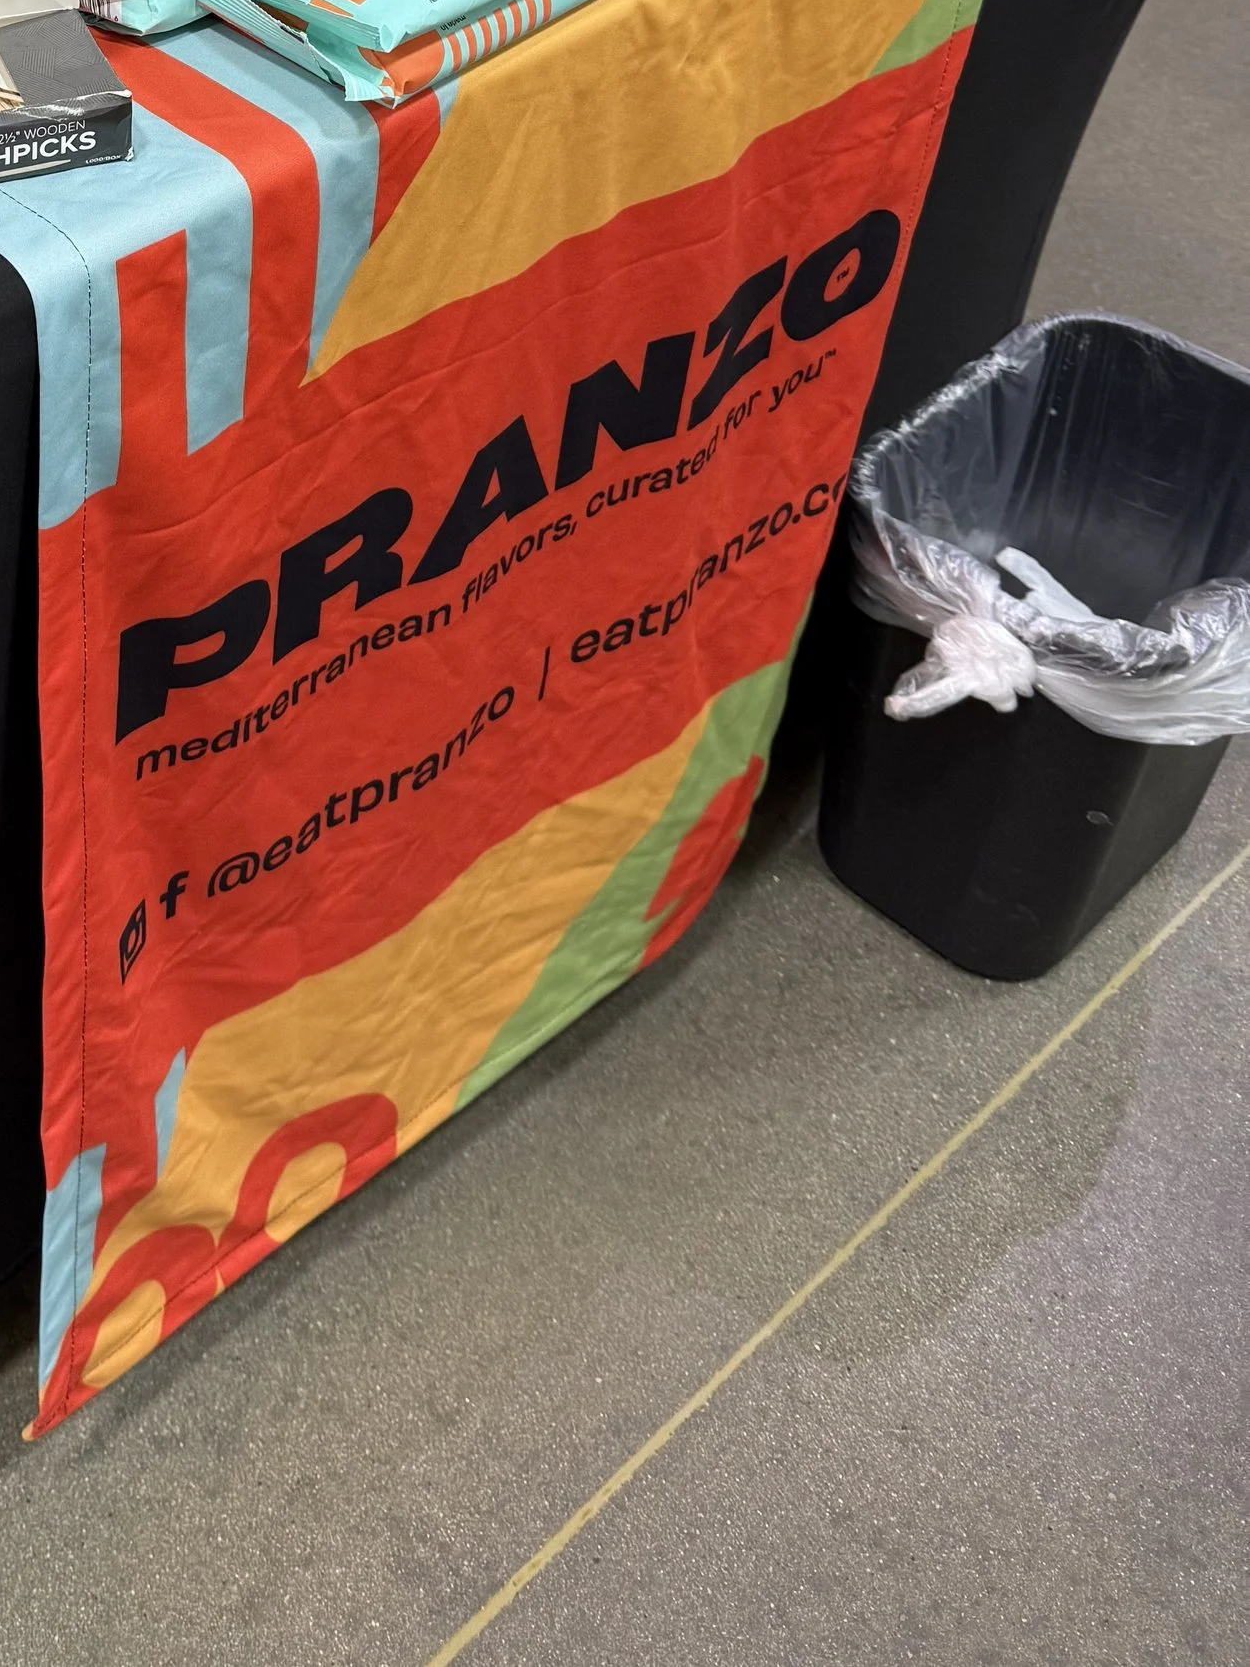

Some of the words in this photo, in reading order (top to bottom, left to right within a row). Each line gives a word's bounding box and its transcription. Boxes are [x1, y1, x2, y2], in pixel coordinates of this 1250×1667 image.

[24, 120, 85, 139] WOODEN
[116, 208, 901, 745] PRANZO
[135, 600, 451, 782] mediterranean
[462, 511, 577, 615] flavors,
[587, 431, 721, 517] curated
[722, 388, 762, 439] for
[207, 686, 515, 898] @eatpranzo
